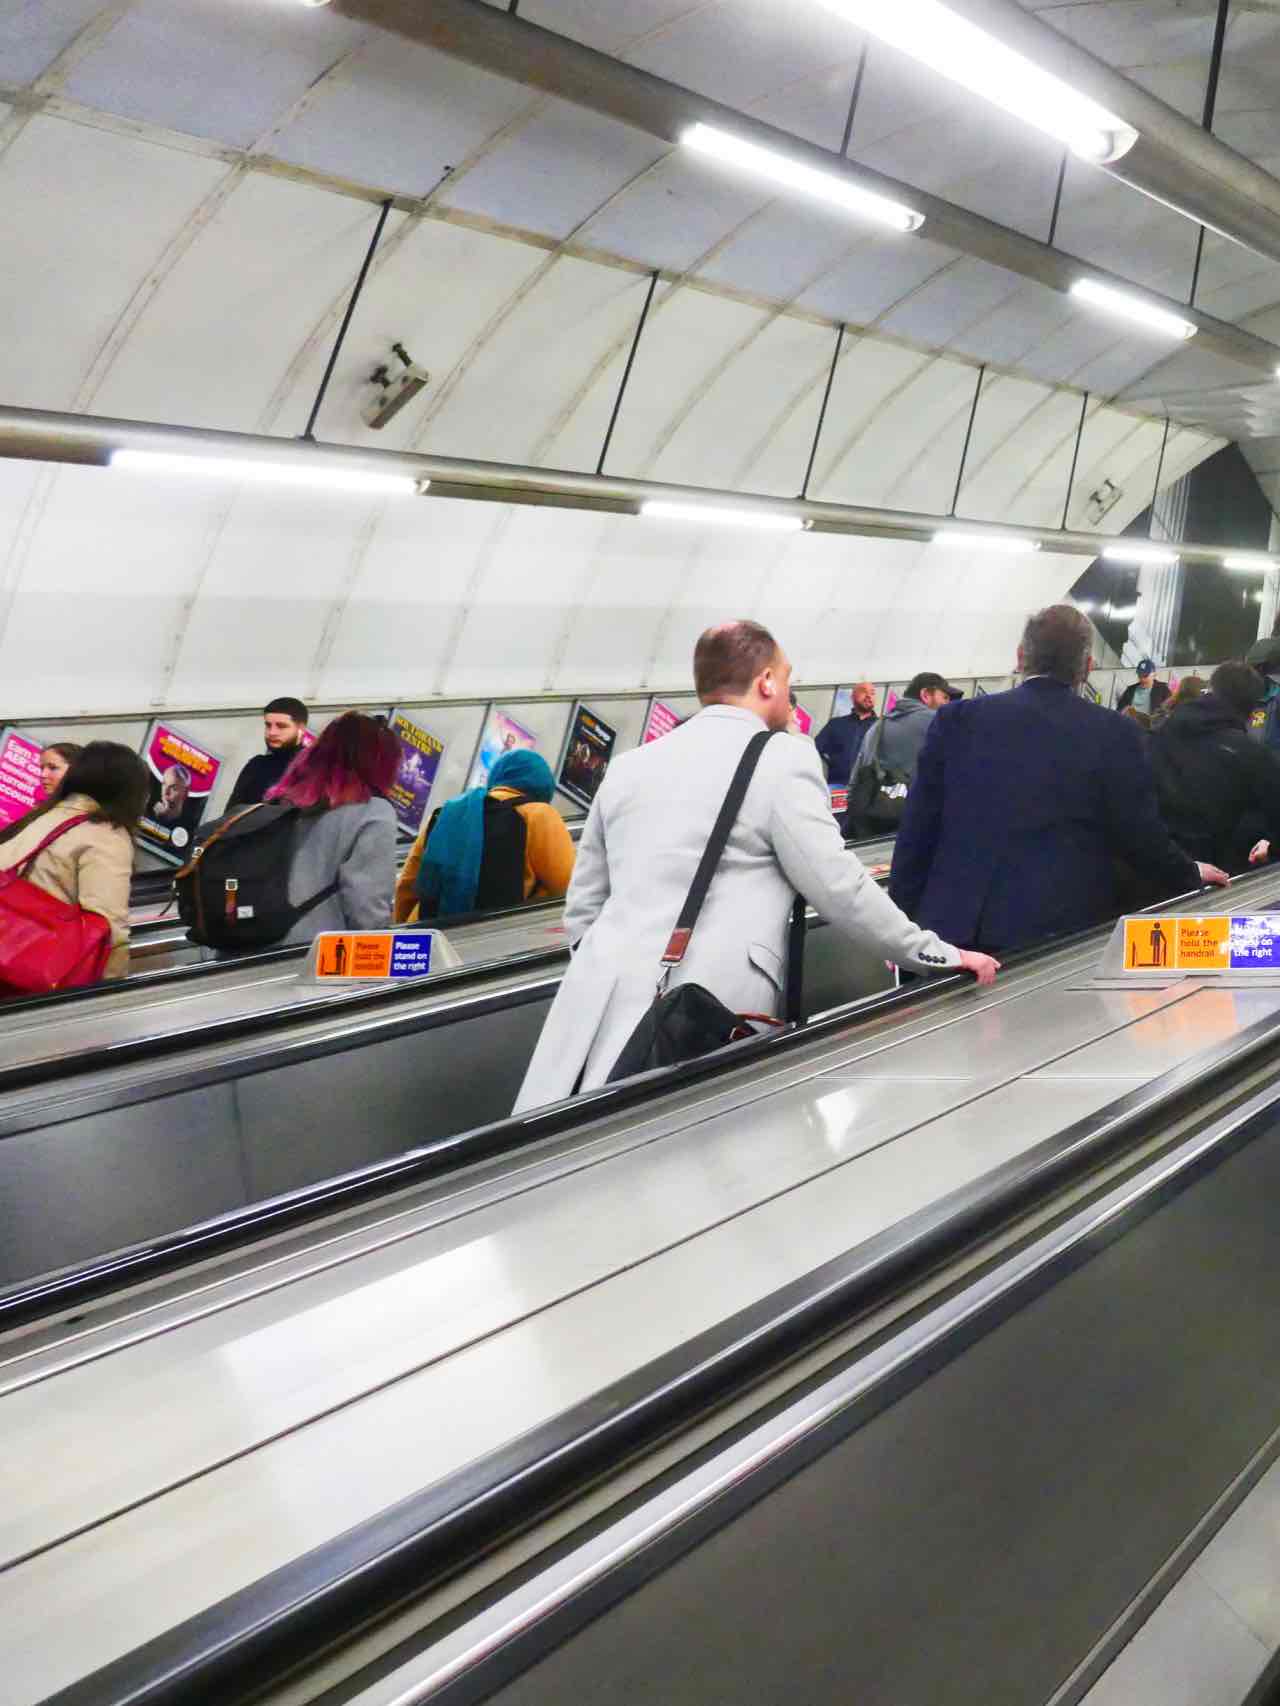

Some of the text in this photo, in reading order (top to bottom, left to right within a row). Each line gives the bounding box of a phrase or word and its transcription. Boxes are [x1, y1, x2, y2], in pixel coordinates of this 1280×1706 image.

[1181, 928, 1209, 937] Please
[395, 942, 420, 950] Please
[1202, 938, 1219, 947] the
[394, 952, 416, 961] stand
[1251, 948, 1273, 958] right
[393, 962, 407, 970] the
[408, 962, 427, 972] right
